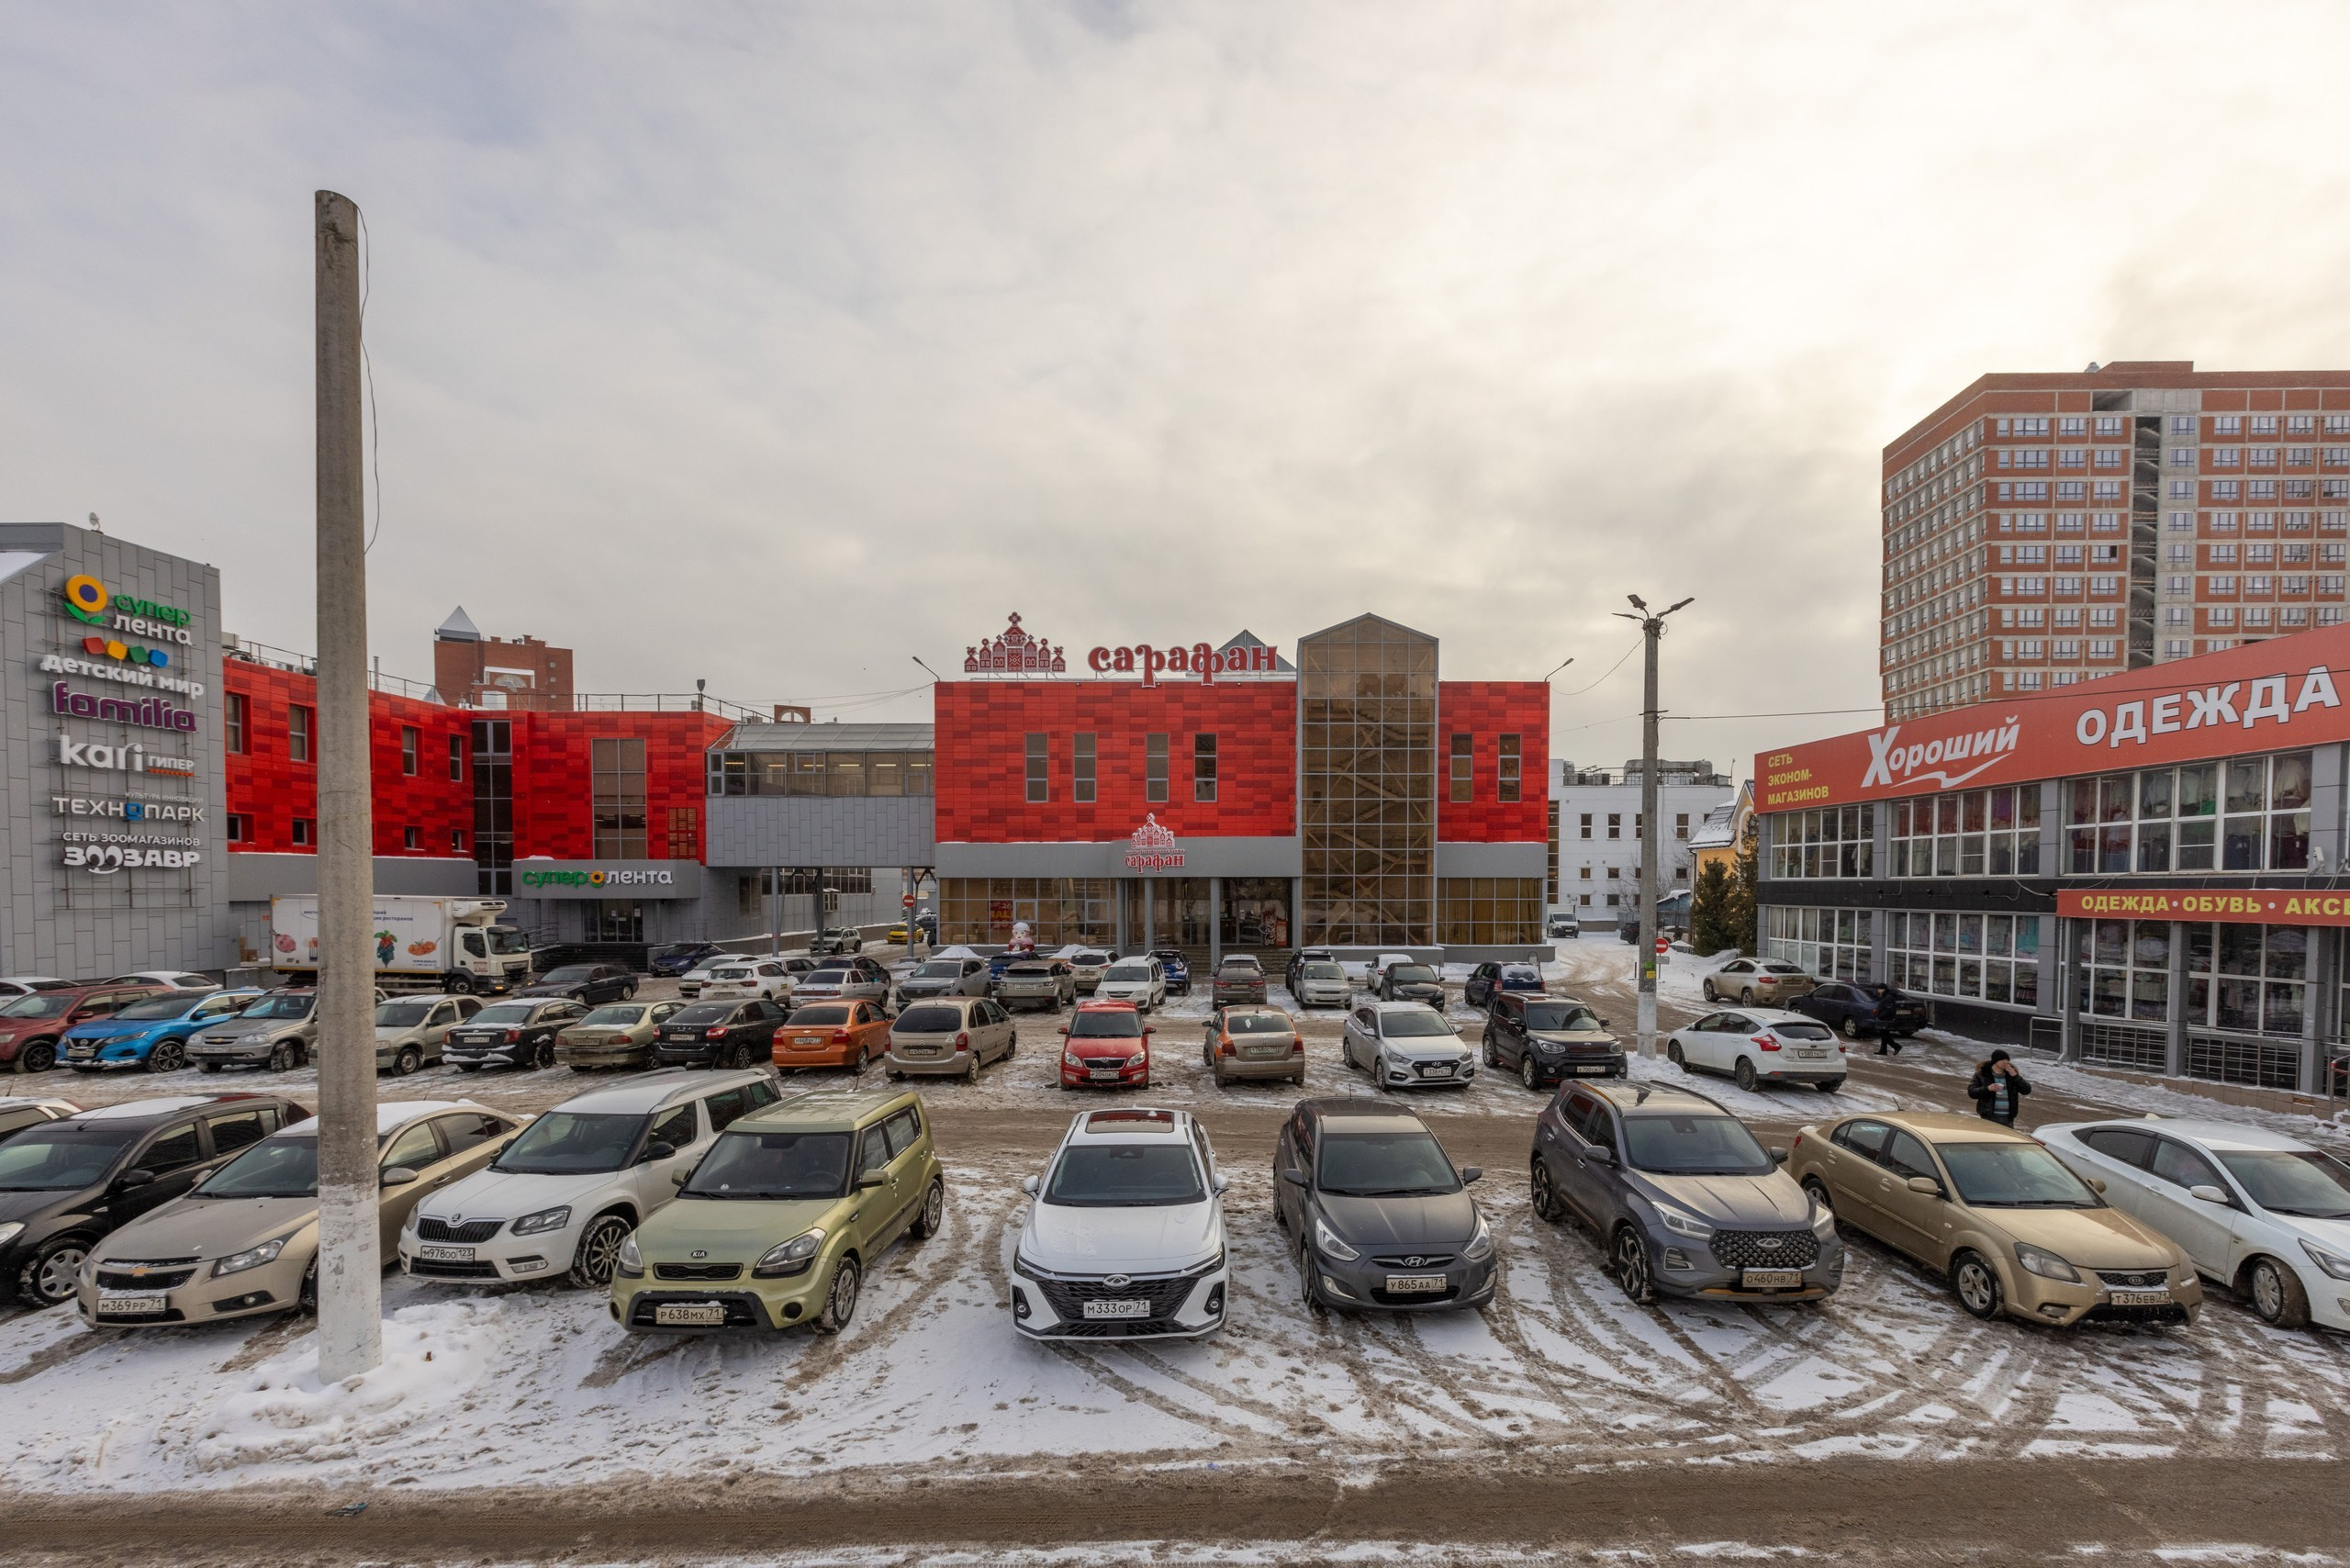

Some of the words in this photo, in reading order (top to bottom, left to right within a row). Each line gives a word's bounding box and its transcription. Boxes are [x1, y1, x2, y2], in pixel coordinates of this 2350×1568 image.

[114, 594, 191, 628] супер
[113, 614, 193, 645] лента
[1088, 642, 1279, 688] сарафан
[159, 676, 205, 700] мир
[53, 680, 196, 734] familia
[2076, 665, 2342, 748] ОДЕЖДА
[60, 734, 143, 772] kari
[1768, 753, 1793, 767] СЕТЬ
[1860, 715, 2020, 789] Хороший
[147, 756, 195, 771] ГИПЕР
[1767, 768, 1812, 787] ЭКОНОМ-
[125, 791, 161, 801] КУЛЬТУРА
[162, 794, 204, 803] ИННОВАЦИЙ
[1767, 785, 1830, 805] МАГАЗИНОВ
[52, 796, 205, 823] ТЕХНОПАРК
[62, 832, 97, 842] СЕТЬ
[101, 834, 200, 846] ЗООМАГАЗИНОВ
[63, 845, 200, 868] ЗООЗАВР
[1125, 854, 1185, 874] сарафан
[521, 870, 588, 889] супер
[606, 870, 673, 884] лента
[2081, 895, 2169, 913] ОДЕЖДА
[2182, 896, 2261, 913] ОБУВЬ
[457, 1249, 474, 1258] 123
